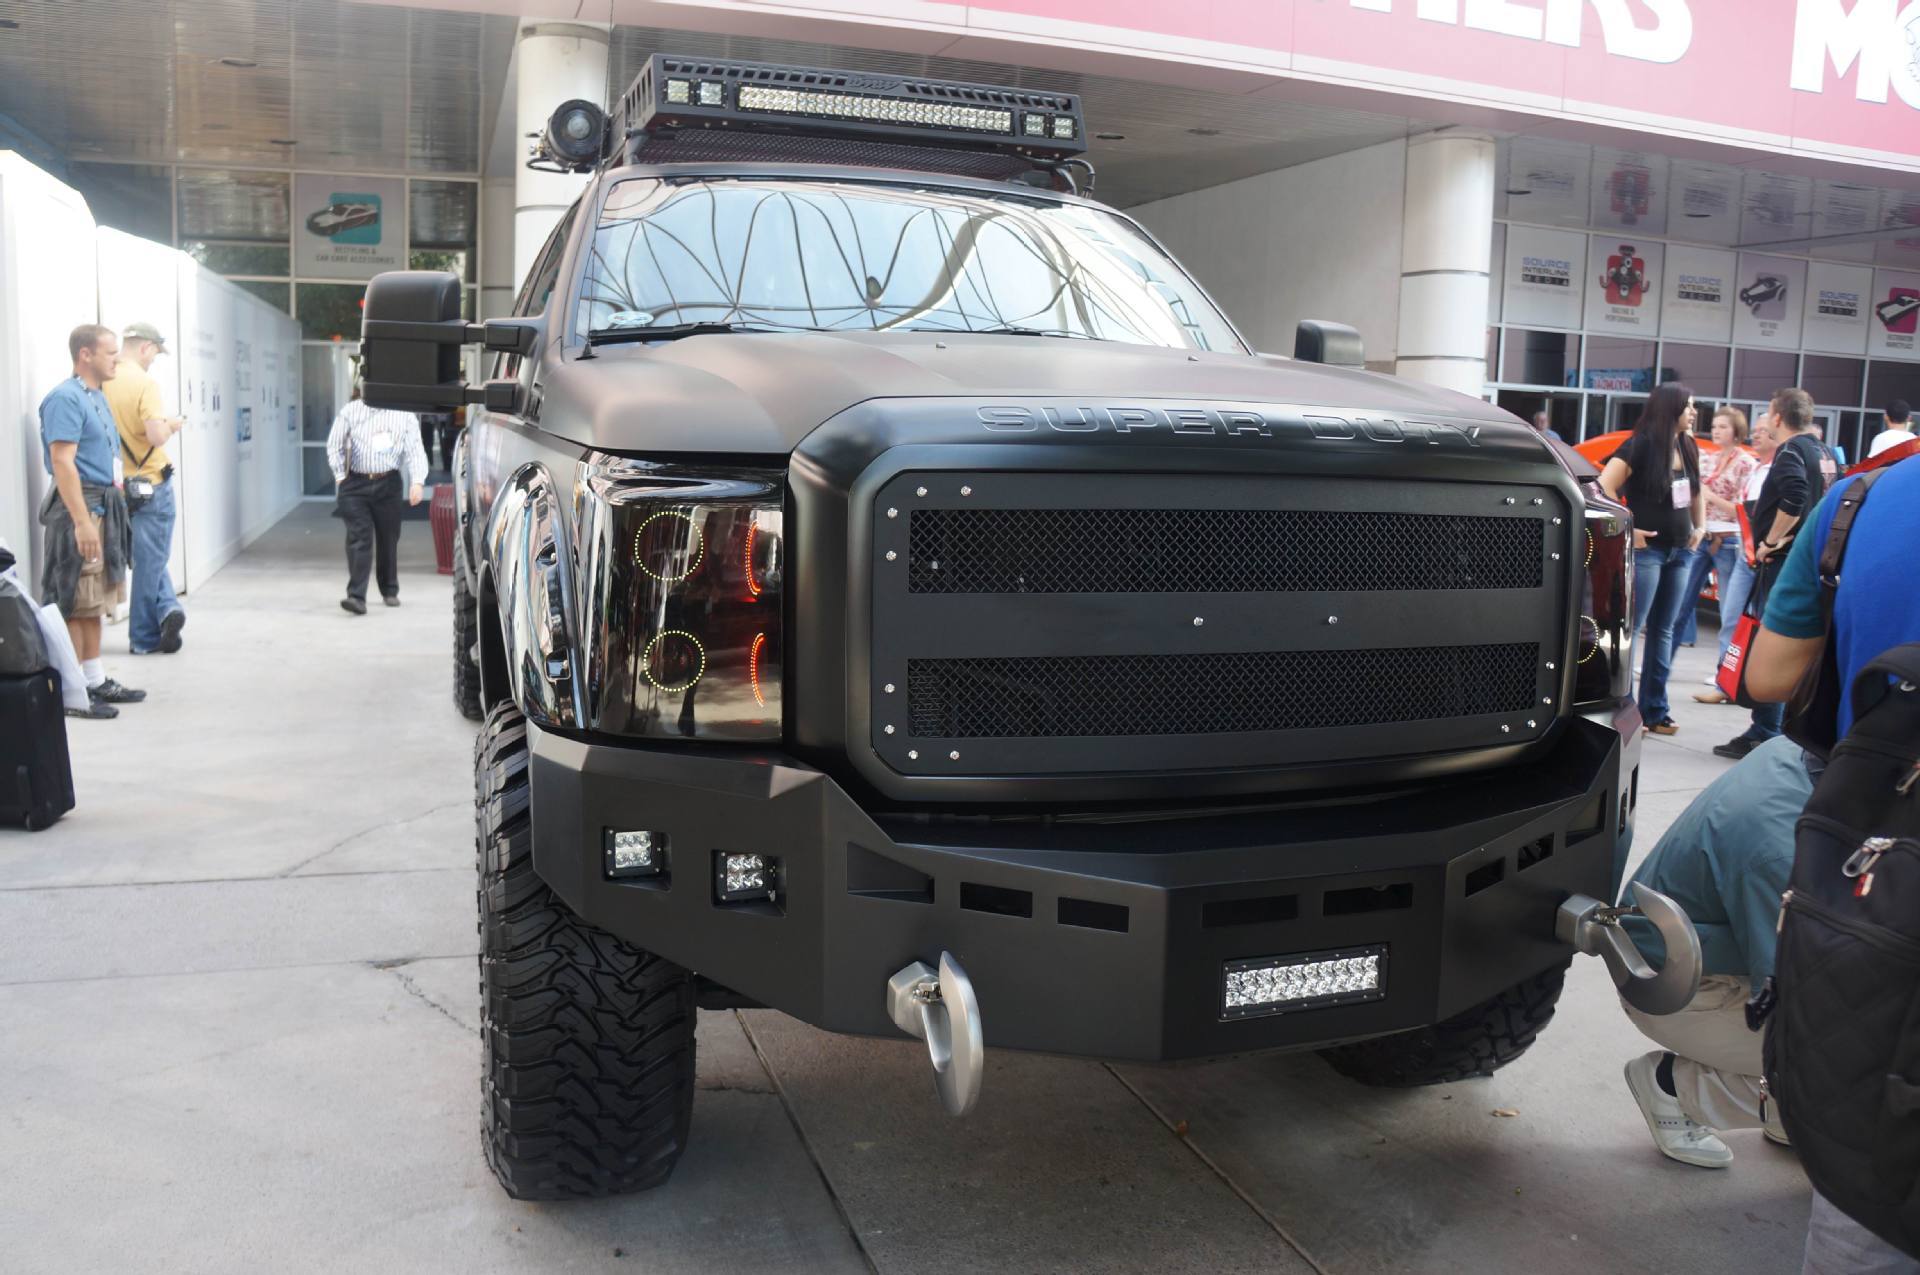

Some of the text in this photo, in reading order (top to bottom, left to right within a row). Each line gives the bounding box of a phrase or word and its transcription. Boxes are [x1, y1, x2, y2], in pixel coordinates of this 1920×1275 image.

[1522, 257, 1570, 269] SOURCE
[1522, 266, 1570, 277] INTERLINK
[1522, 274, 1569, 287] MEDIA
[1679, 275, 1721, 286] SOURCE
[976, 405, 1480, 448] SUPER DUTY
